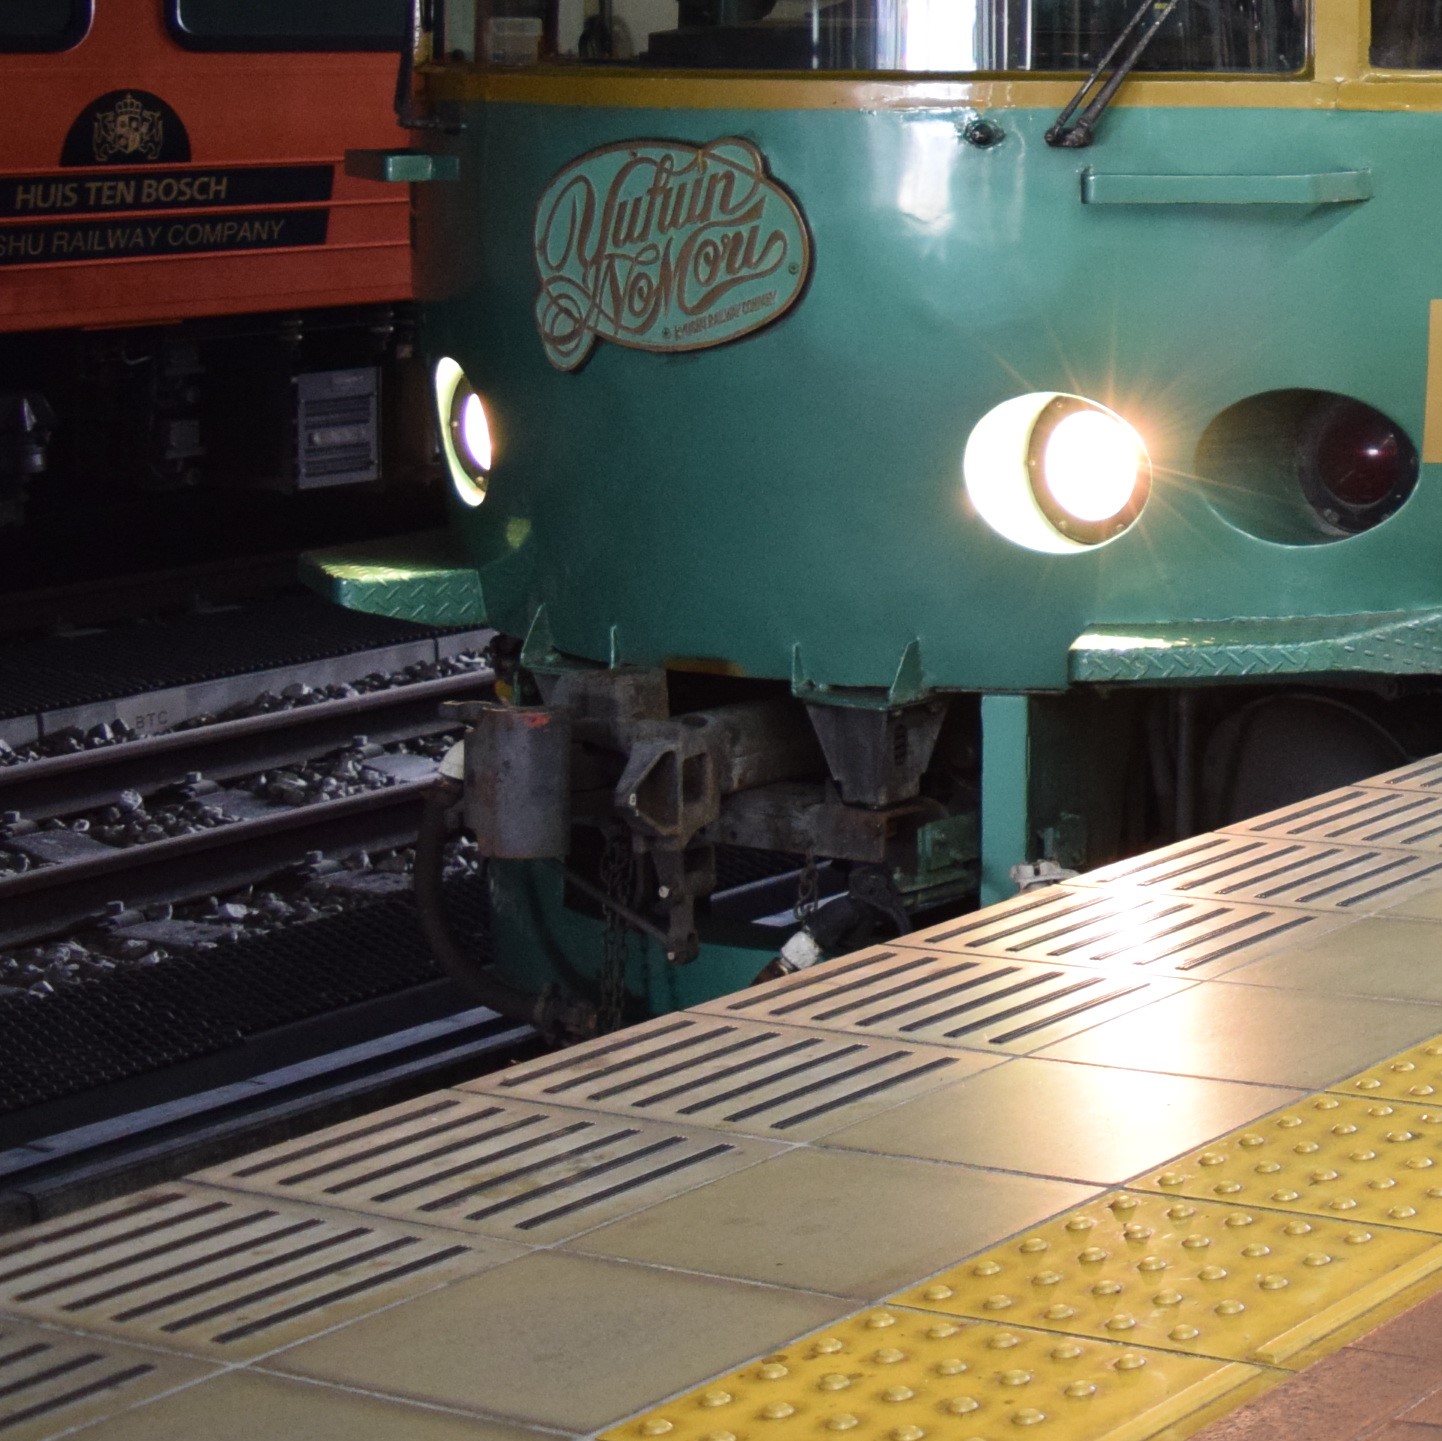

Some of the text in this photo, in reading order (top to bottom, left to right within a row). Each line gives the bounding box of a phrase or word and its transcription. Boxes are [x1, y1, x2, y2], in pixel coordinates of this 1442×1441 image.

[15, 176, 229, 210] HUIS TEN BOSCH
[544, 152, 762, 273] Yufuin
[52, 225, 164, 253] RAILWAY
[167, 218, 287, 246] COMPANY
